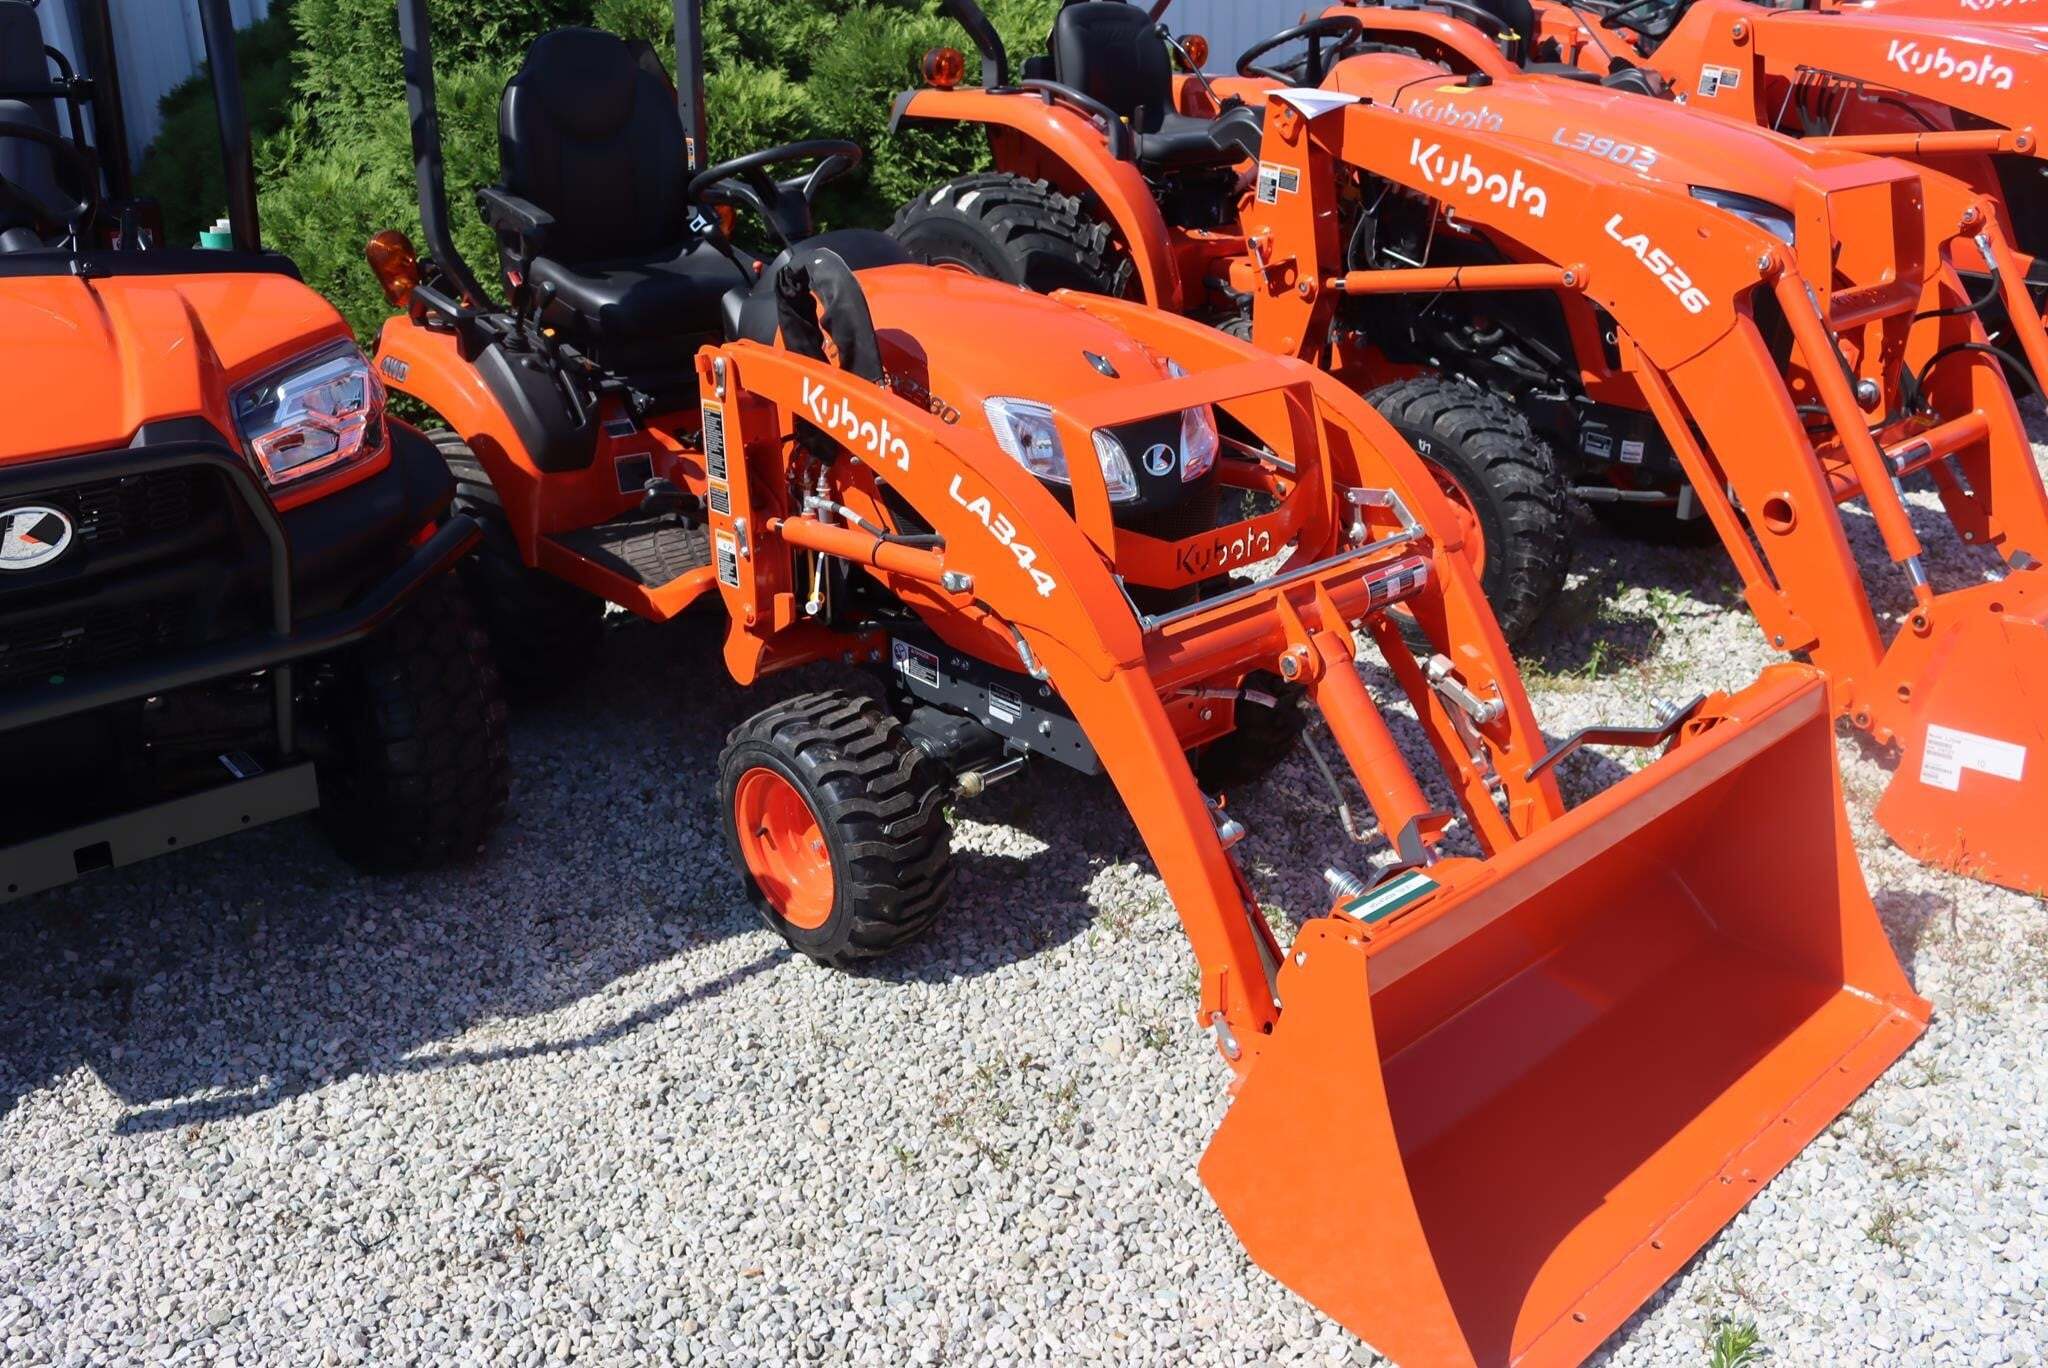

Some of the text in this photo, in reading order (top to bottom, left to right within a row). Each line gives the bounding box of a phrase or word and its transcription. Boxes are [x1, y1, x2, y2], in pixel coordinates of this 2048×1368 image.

[1887, 39, 2014, 90] Kubota
[1408, 98, 1505, 132] Kubota
[1409, 137, 1548, 218] Kubota
[1552, 126, 1659, 173] L3902
[1604, 213, 1711, 314] LA526
[802, 375, 911, 472] Kubota
[949, 473, 1057, 598] LA344
[1176, 526, 1270, 576] Kubota
